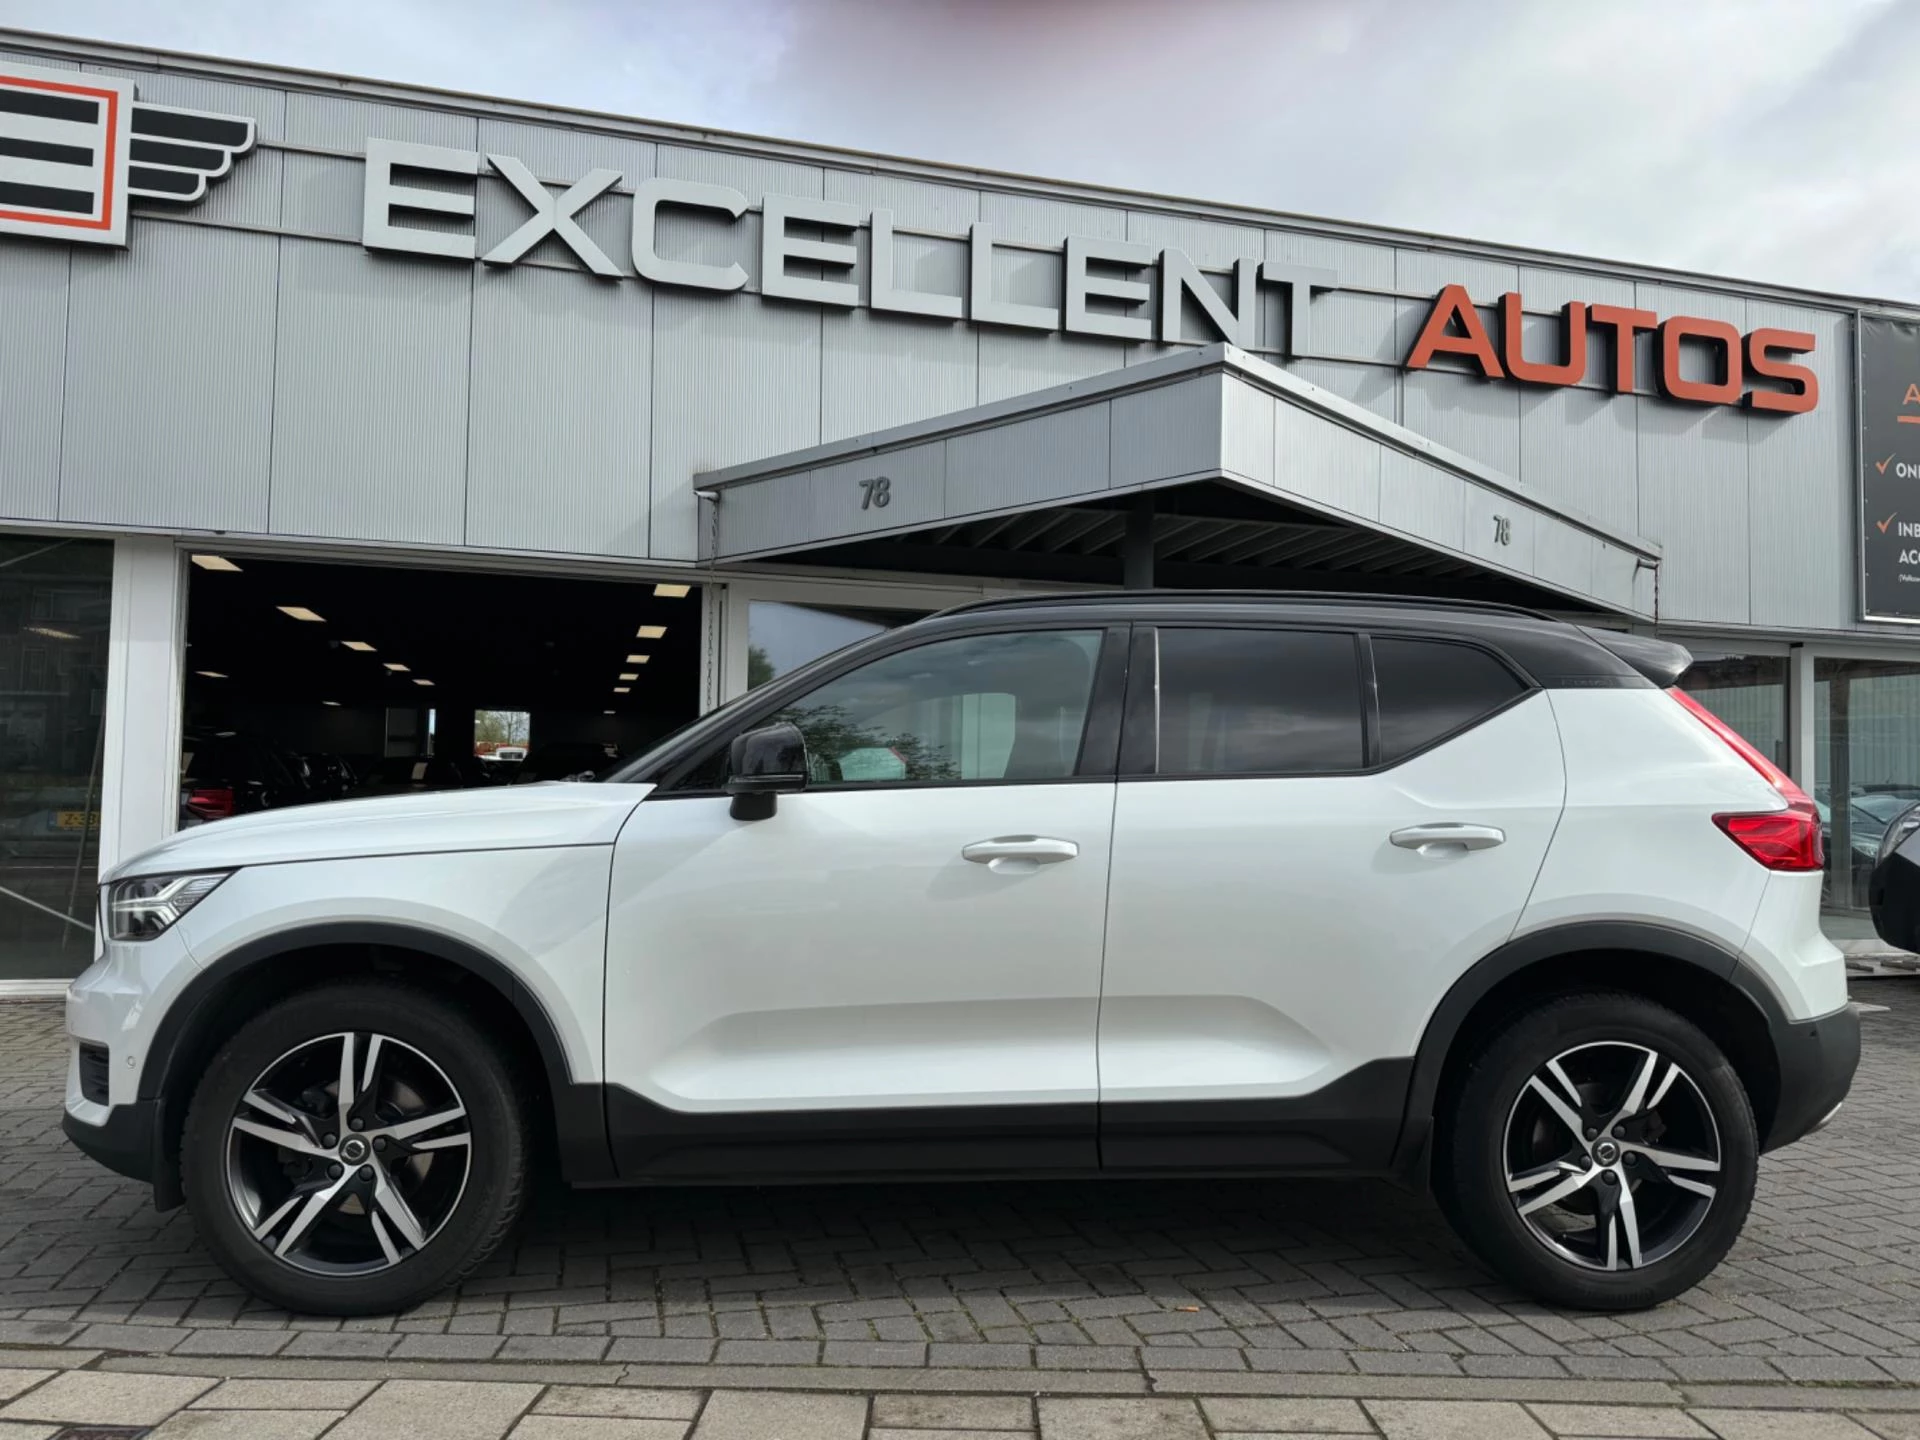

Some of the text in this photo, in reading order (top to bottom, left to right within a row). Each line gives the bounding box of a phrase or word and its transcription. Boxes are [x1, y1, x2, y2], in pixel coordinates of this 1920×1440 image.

[362, 136, 1820, 414] EXCELLENT AUTOS
[859, 476, 891, 510] 78
[1493, 515, 1511, 546] 78
[1898, 549, 1920, 565] AC
